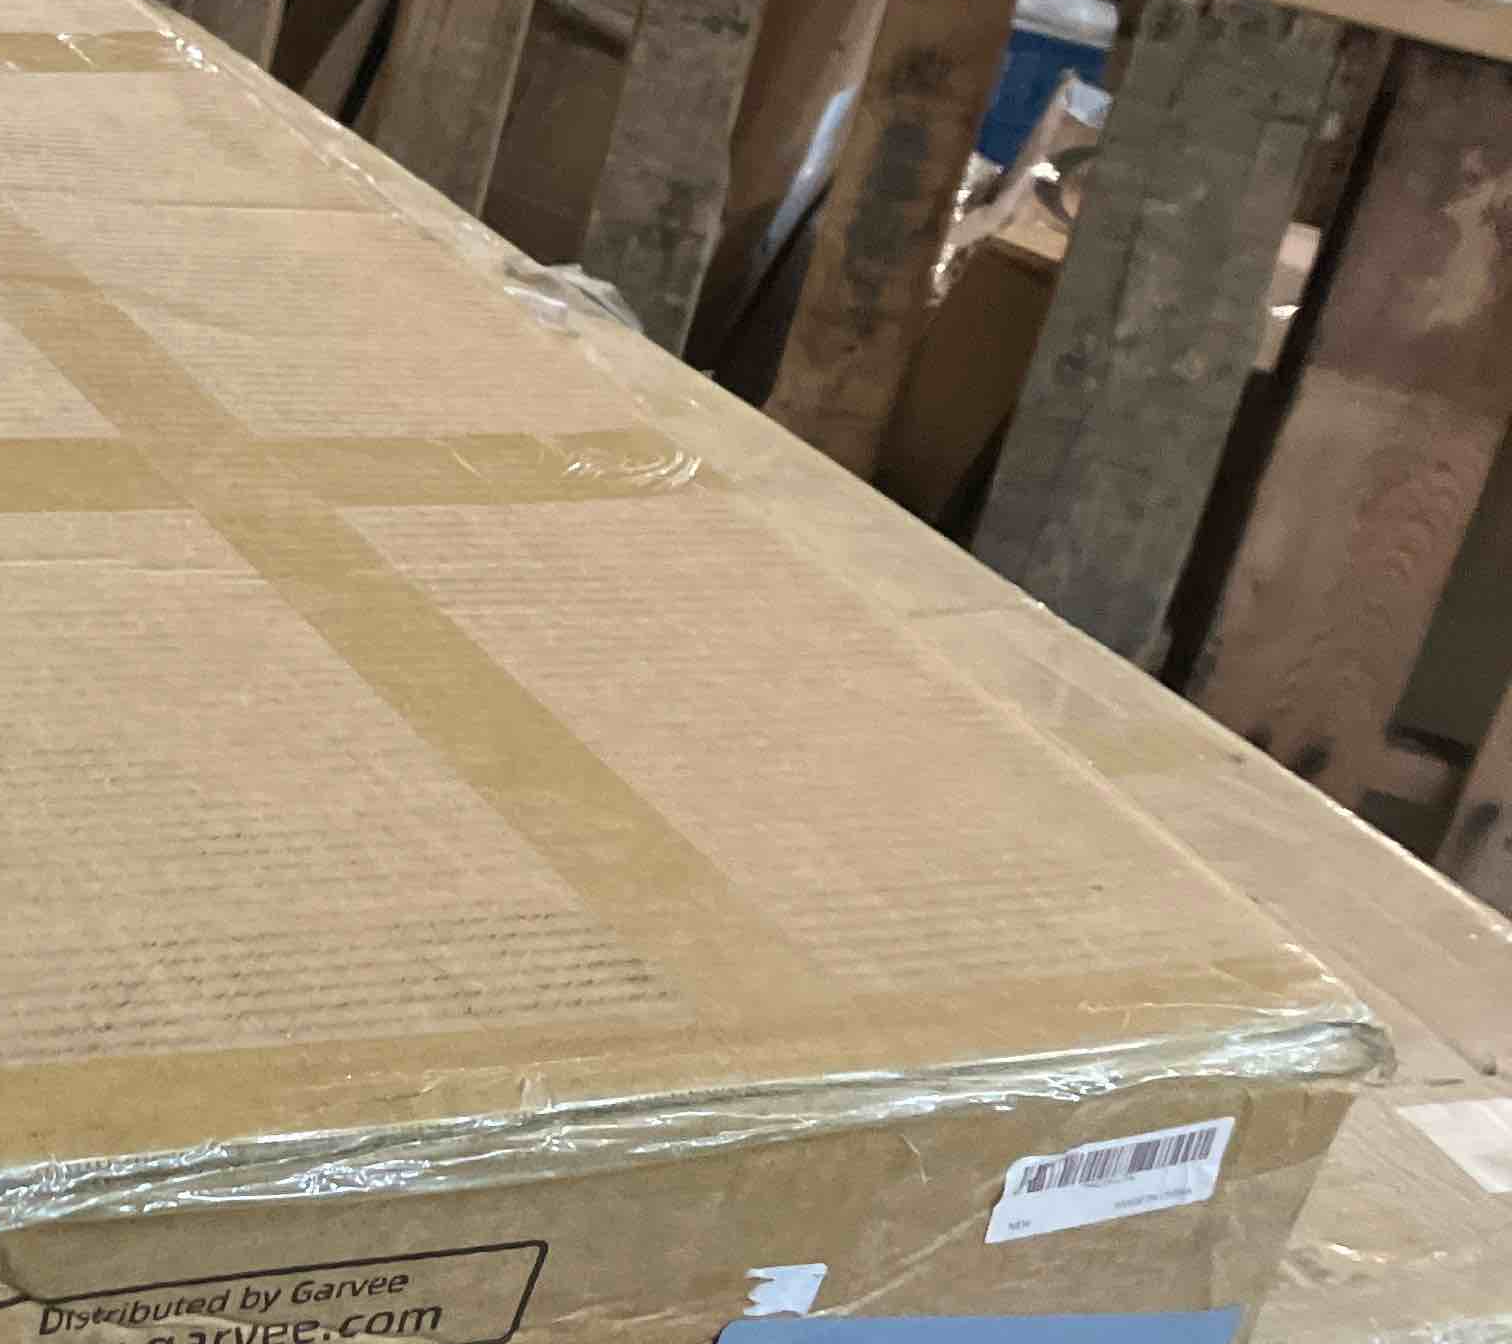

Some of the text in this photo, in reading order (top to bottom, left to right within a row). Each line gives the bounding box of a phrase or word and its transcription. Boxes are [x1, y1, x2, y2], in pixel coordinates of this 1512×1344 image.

[39, 1271, 410, 1336] Distributed by Garvee
